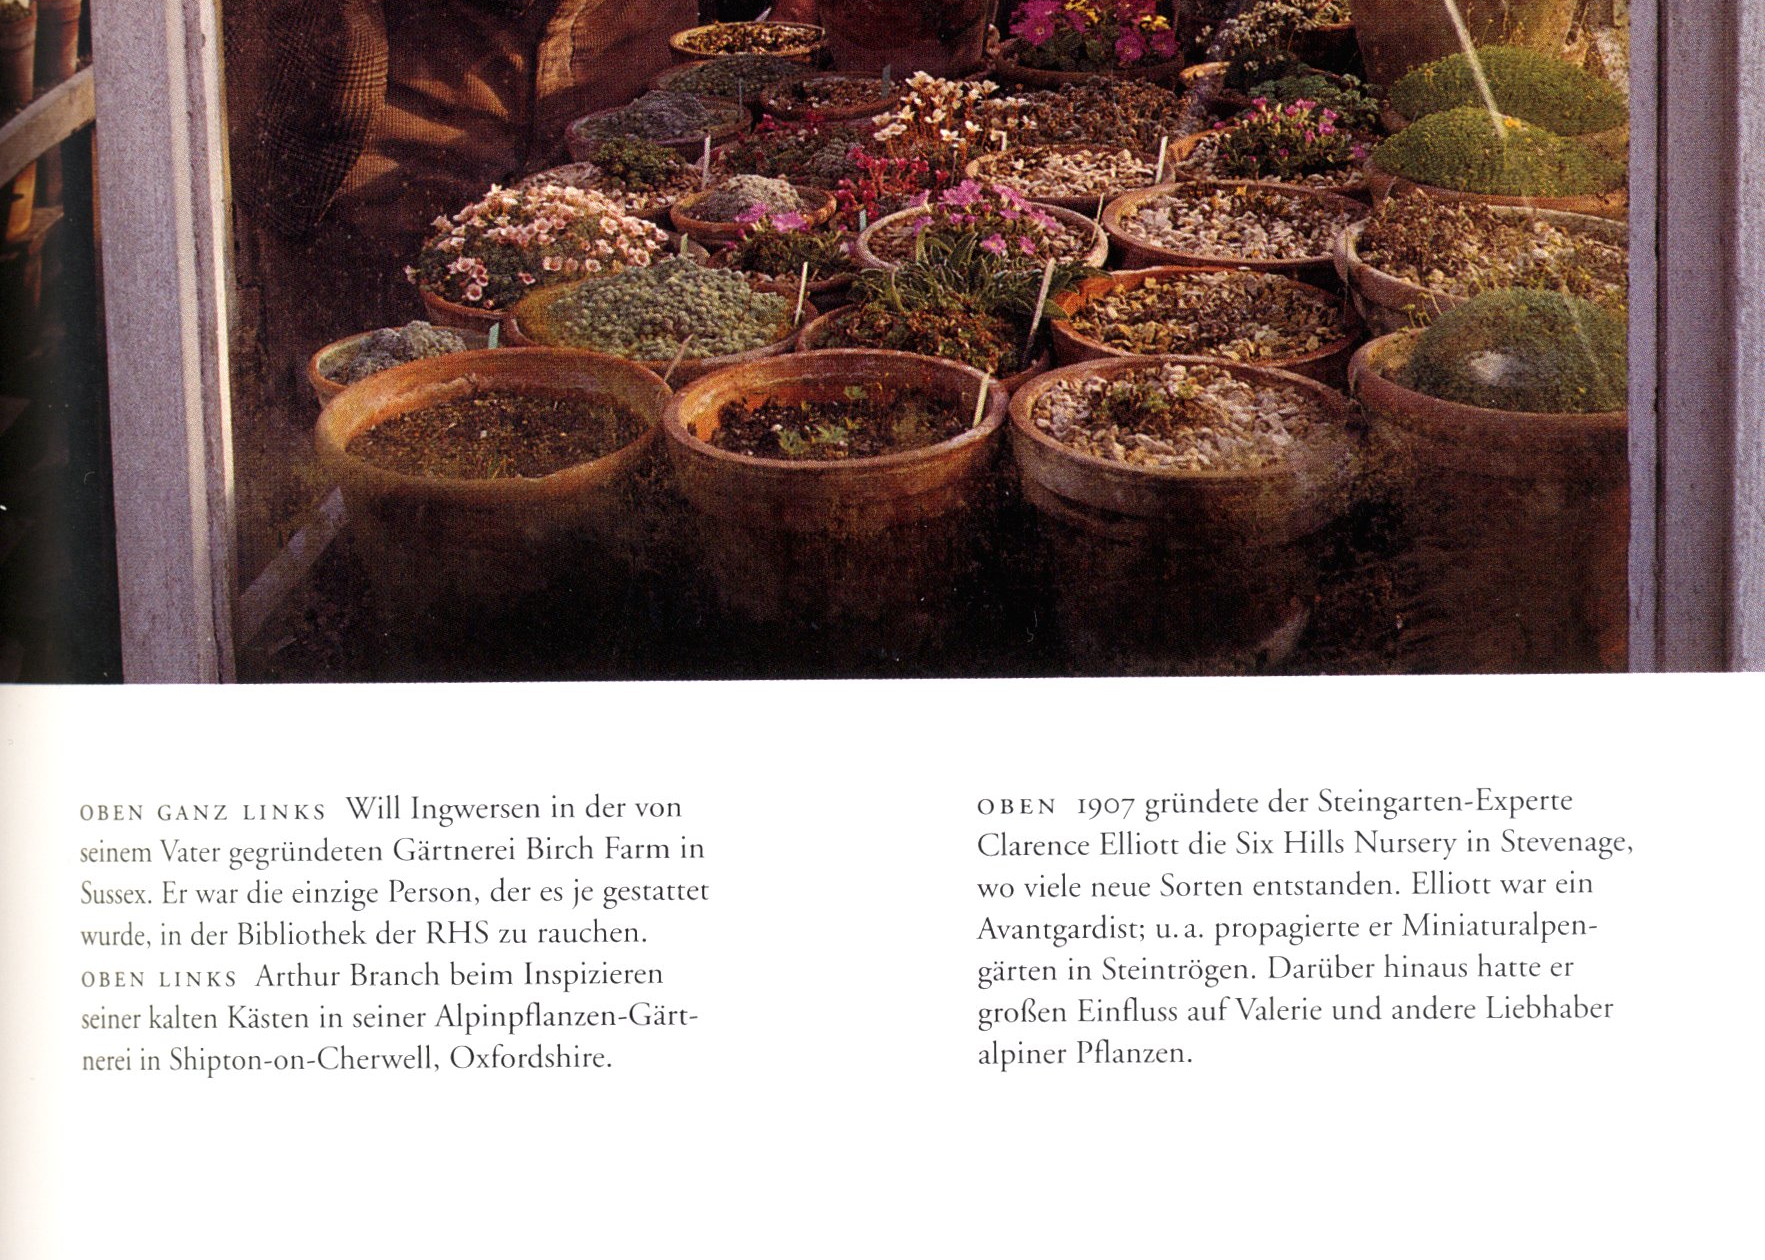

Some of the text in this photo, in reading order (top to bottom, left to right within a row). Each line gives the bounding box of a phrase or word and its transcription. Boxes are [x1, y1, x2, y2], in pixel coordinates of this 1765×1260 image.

[81, 794, 680, 827] OBEN GANZ LINKS Will Ingwersen in der von
[978, 788, 1572, 822] OBEN 1907 gründete der Steingarten-Experte
[81, 836, 703, 870] seinem Vater gegründeten Gärtnerei Birch Farm in
[978, 829, 1632, 860] Clarence Elliott die Six Hills Nursery in Stevenage,
[82, 878, 708, 911] Sussex. Er war die einzige Person, der es je gestattet
[977, 870, 1592, 897] wo viele neue Sorten entstanden. Elliott war ein
[82, 919, 646, 948] wurde, in der Bibliothek der RHS zu rauchen.
[977, 915, 1144, 947] Avantgardist;
[1216, 915, 1359, 945] propagierte
[1369, 922, 1392, 936] er
[1402, 911, 1597, 943] Miniaturalpen-
[82, 962, 663, 992] OBEN LINKS Arthur Branch beim Inspizieren
[978, 953, 1574, 989] gärten in Steintrögen. Darüber hinaus hatte er
[83, 1002, 697, 1035] seiner kalten Kästen in seiner Alpinpflanzen-Gärt-
[979, 994, 1613, 1031] großen Einfluss auf Valerie und andere Liebhaber
[84, 1044, 611, 1078] nerei in Shipton-on-Cherwell, Oxfordshire.
[979, 1039, 1191, 1072] alpiner Pflanzen.
